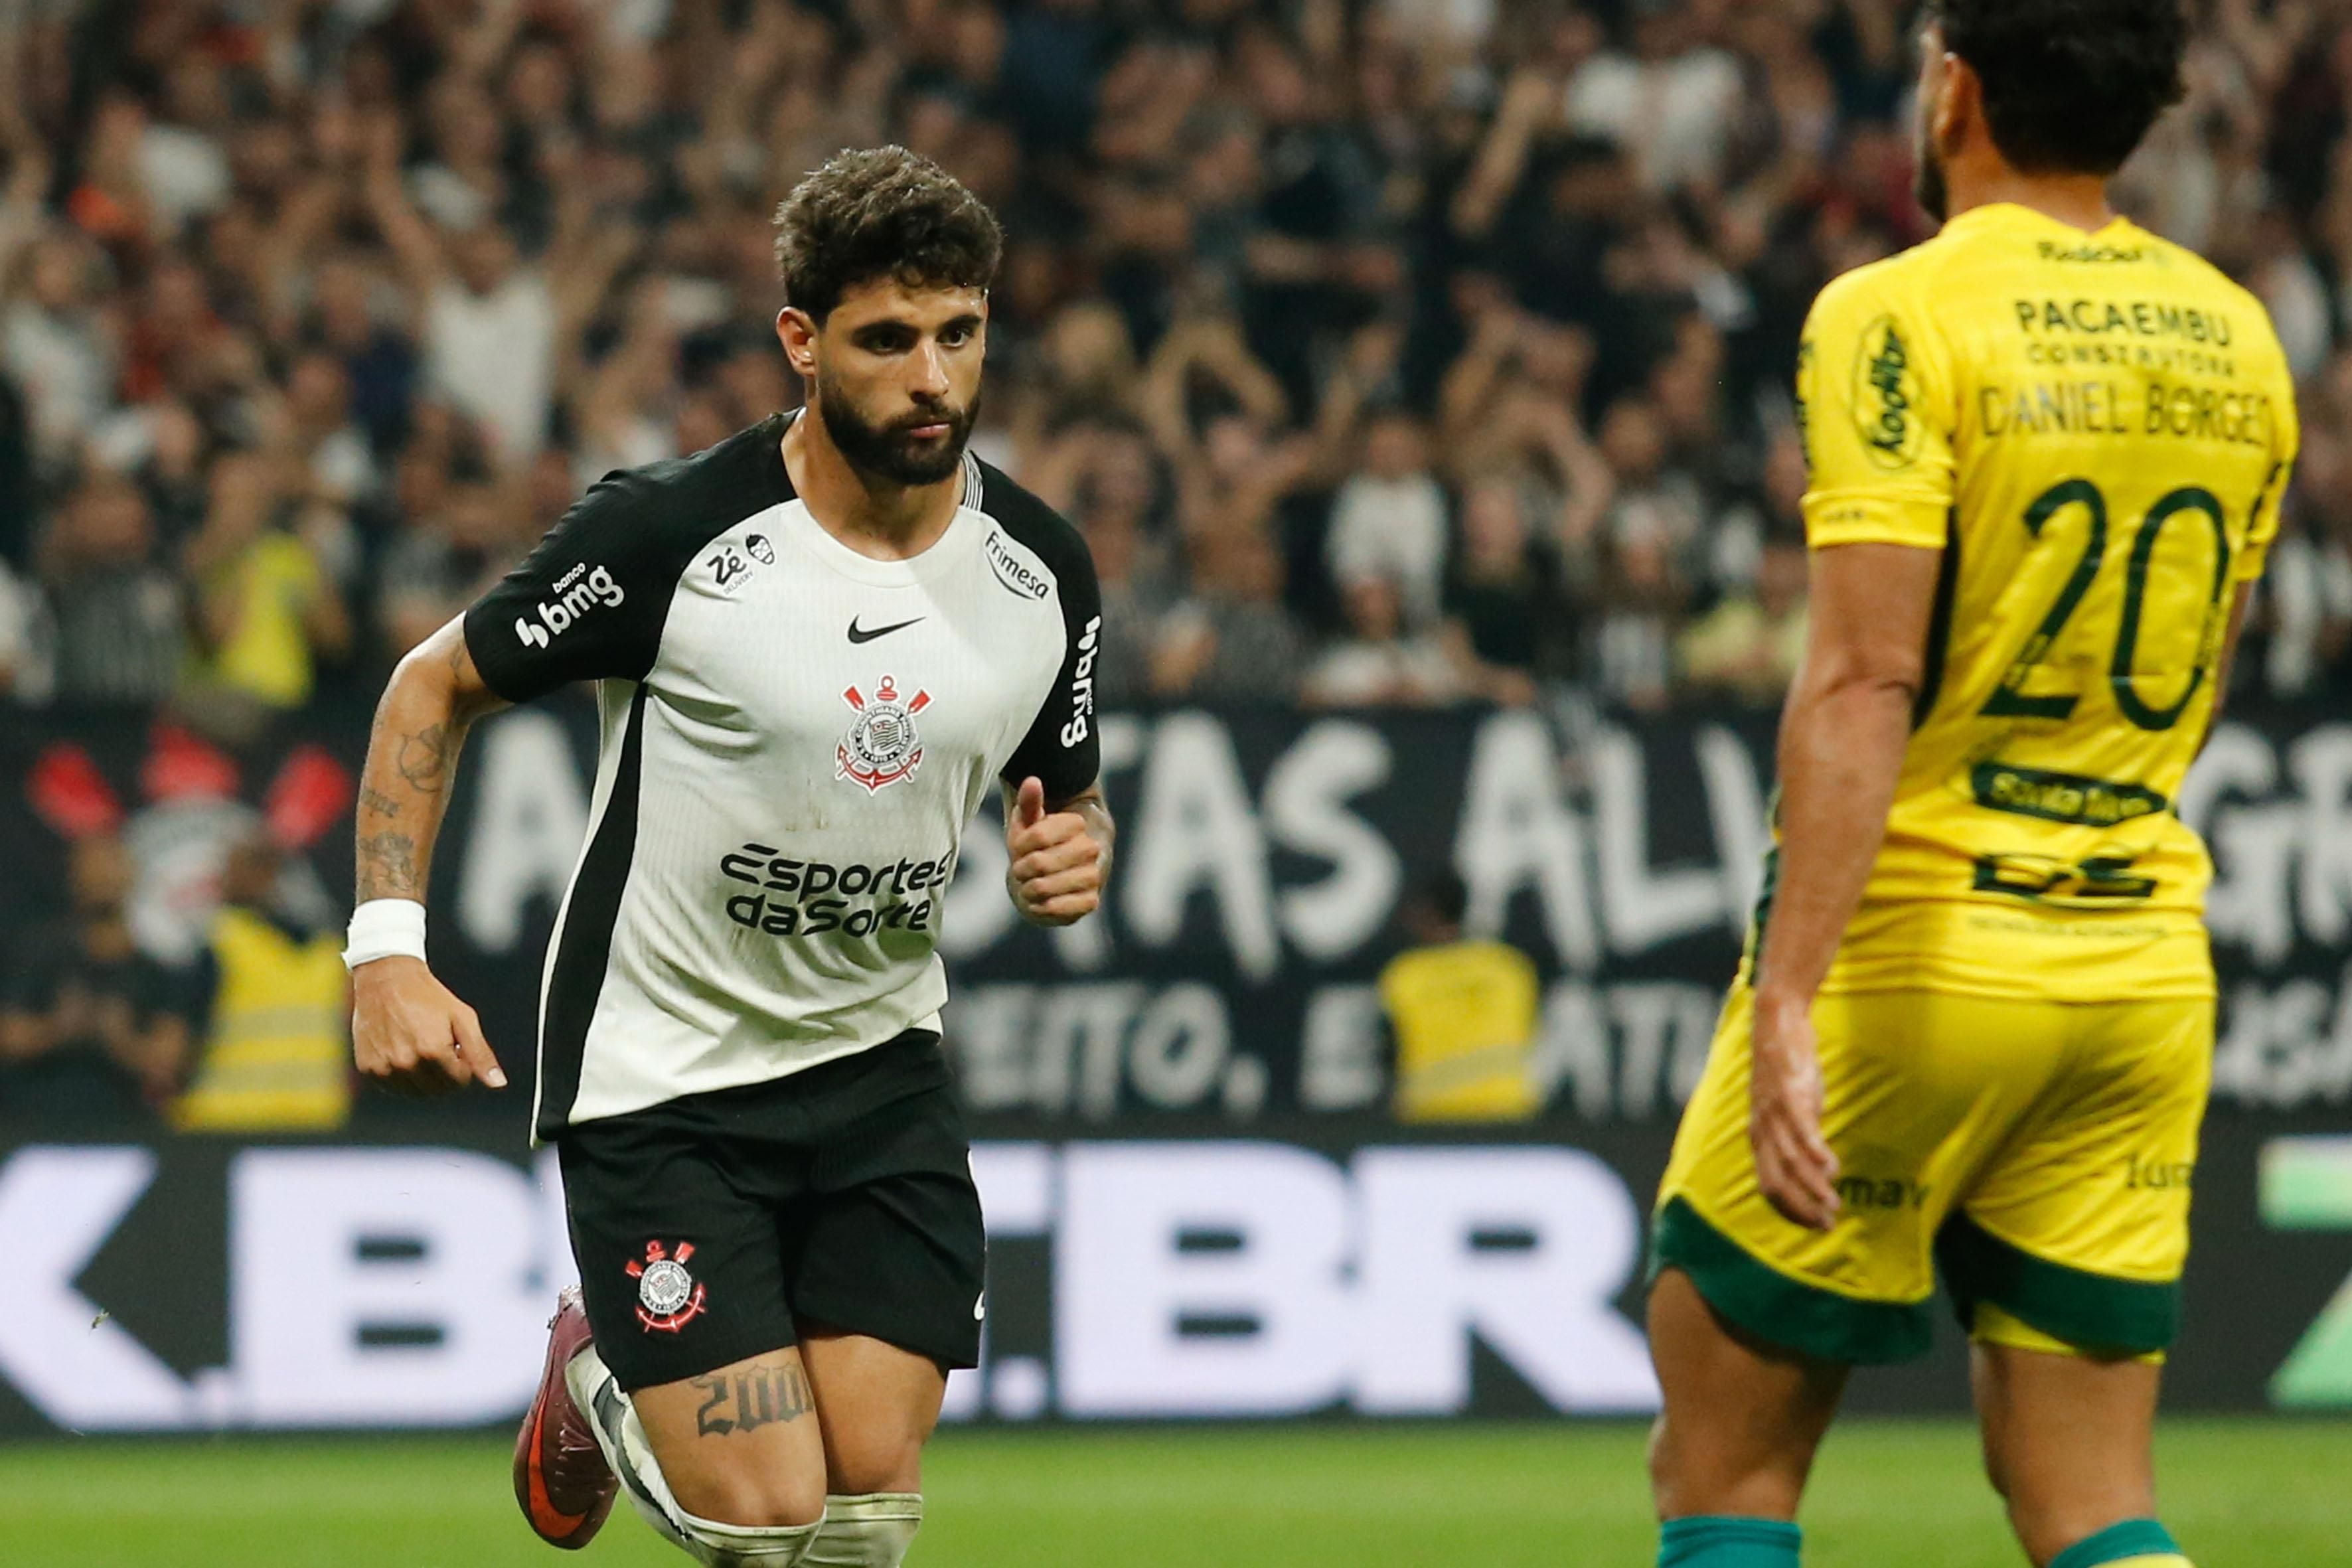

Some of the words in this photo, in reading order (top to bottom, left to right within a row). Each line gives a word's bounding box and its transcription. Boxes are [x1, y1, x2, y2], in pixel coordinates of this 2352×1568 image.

[2014, 299, 2231, 348] PACAEMBU
[1978, 378, 2128, 438] DANIEL
[552, 562, 586, 594] banco
[706, 546, 747, 586] Zé
[985, 530, 1050, 600] Frimesa
[538, 565, 625, 636] bmg
[1976, 477, 2231, 732] 20
[721, 843, 952, 904] Esportes
